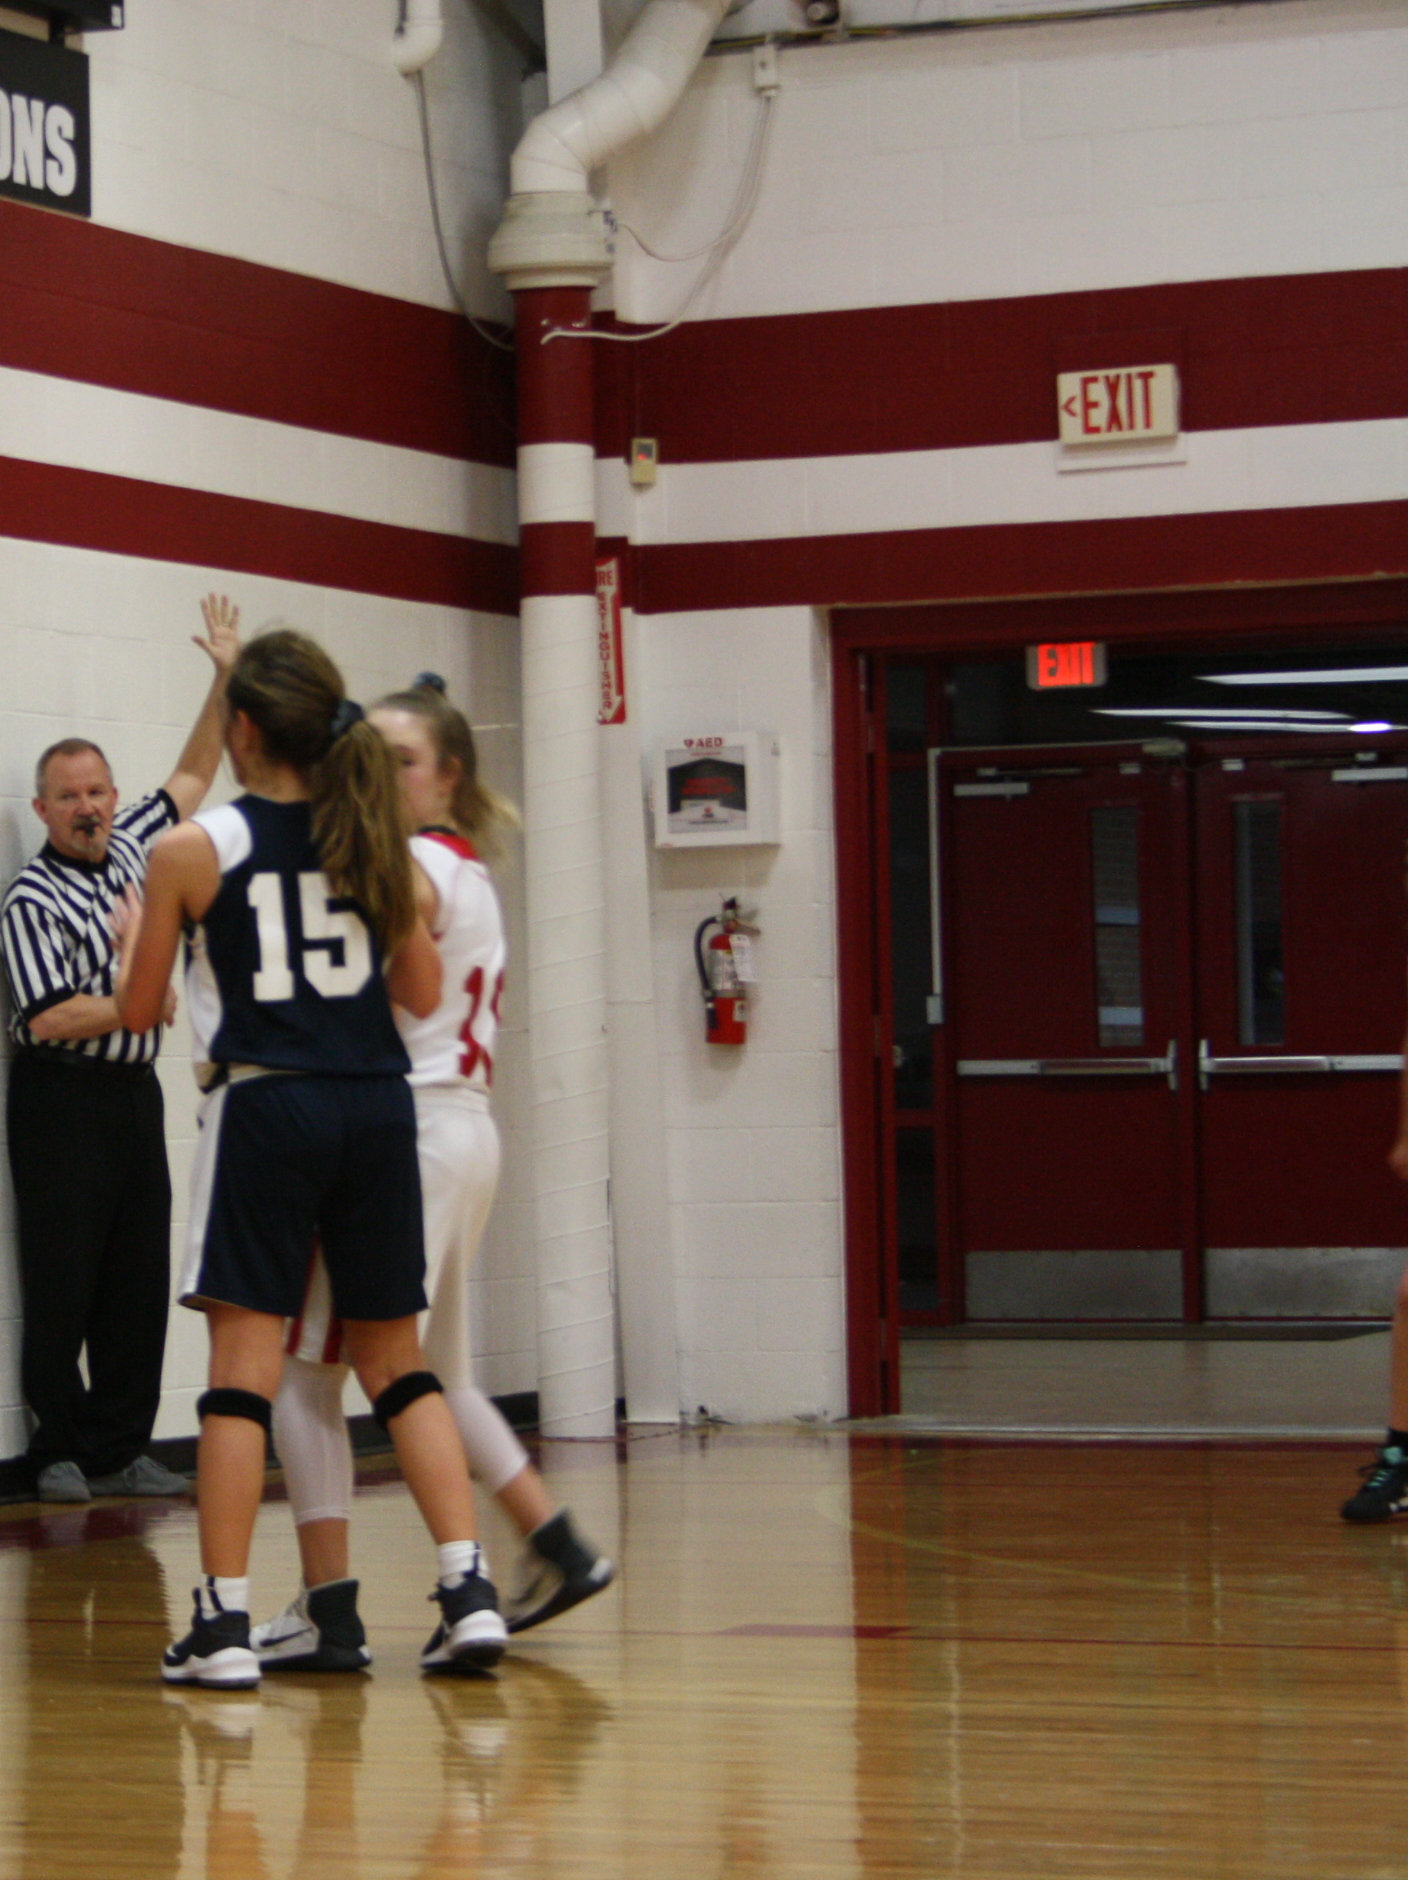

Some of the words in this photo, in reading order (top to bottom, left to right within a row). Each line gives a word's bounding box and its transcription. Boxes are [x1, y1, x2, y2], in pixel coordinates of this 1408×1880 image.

[1080, 371, 1156, 435] EXIT
[597, 591, 613, 710] EXTINGUISHER
[1037, 641, 1096, 687] EXIT
[696, 737, 724, 749] AED
[247, 871, 373, 1003] 15
